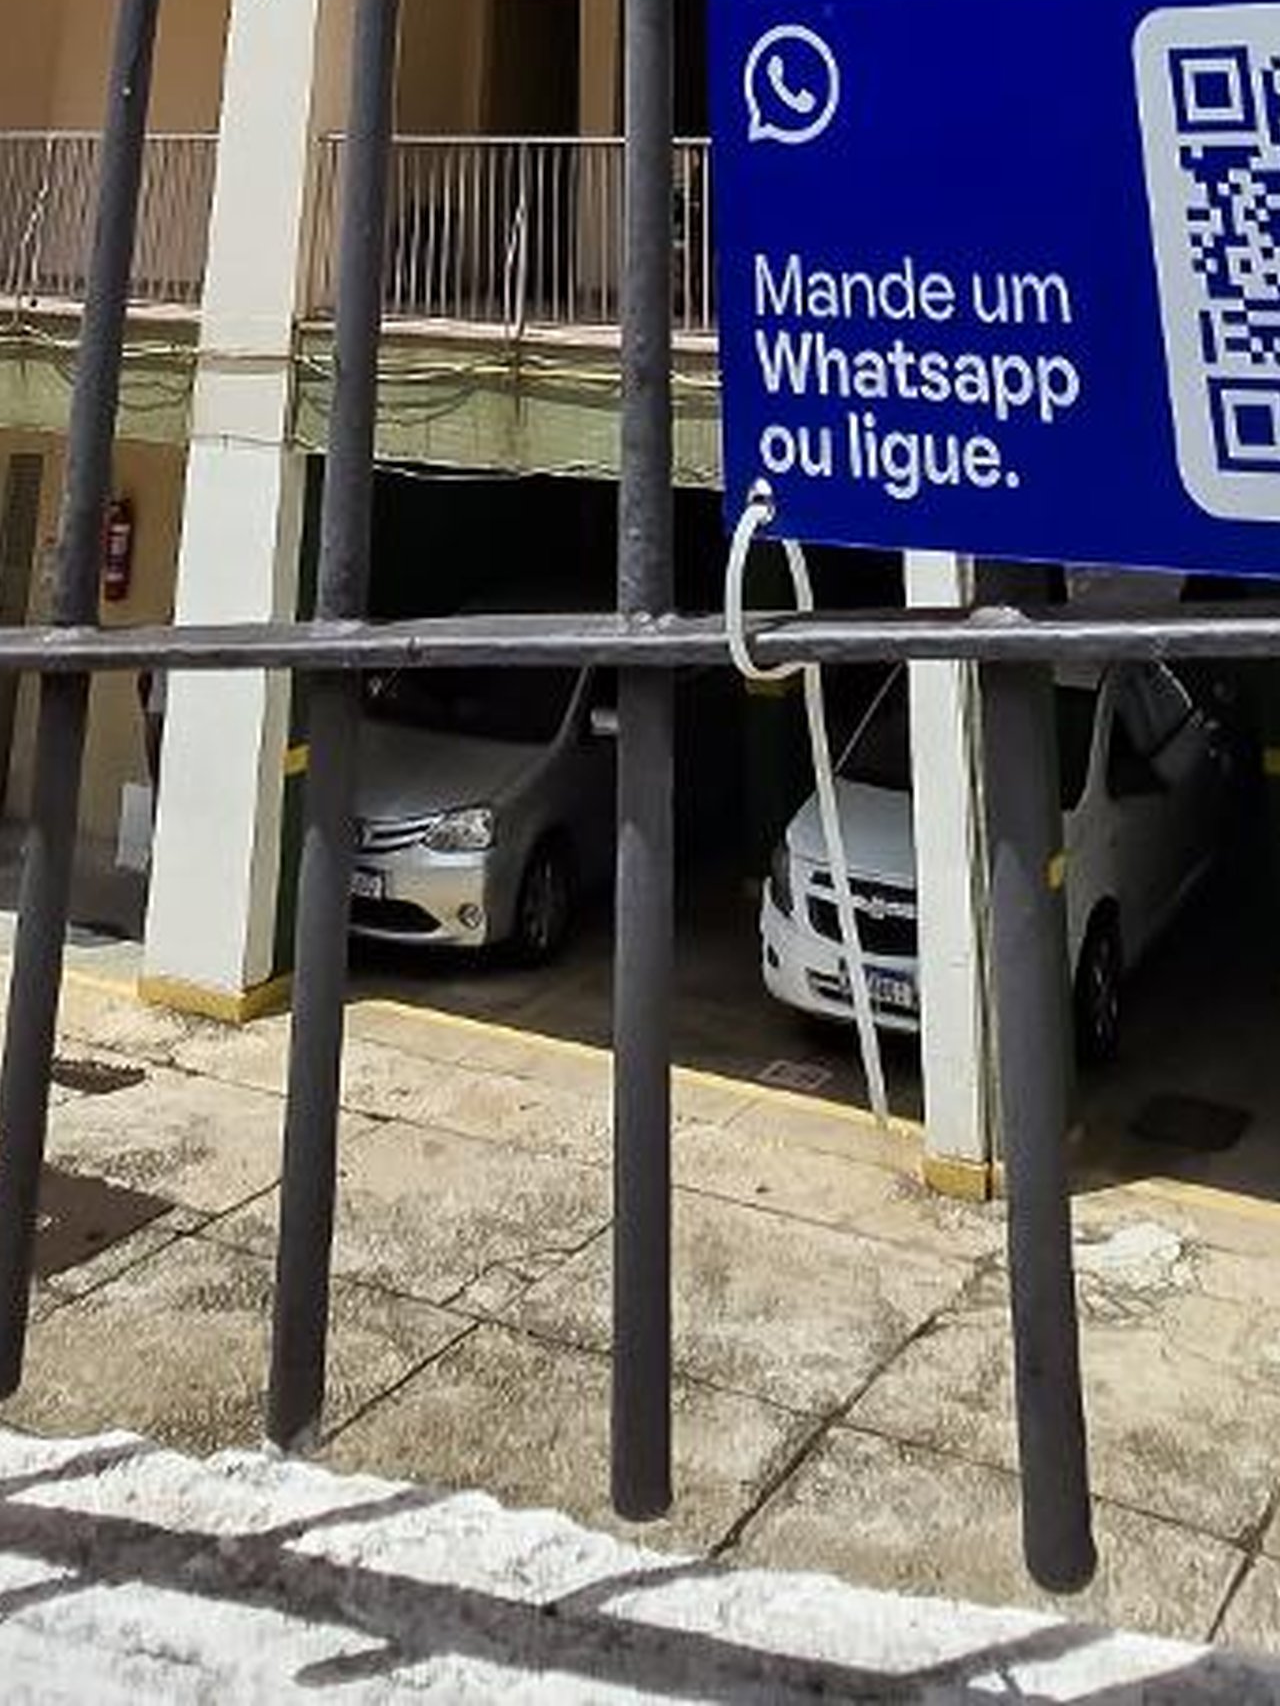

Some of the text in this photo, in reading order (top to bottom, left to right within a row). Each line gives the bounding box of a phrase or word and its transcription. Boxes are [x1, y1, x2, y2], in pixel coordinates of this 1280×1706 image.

[755, 254, 1071, 323] Mande um
[755, 330, 1080, 423] Whatsapp
[760, 411, 1019, 499] ou ligue.
